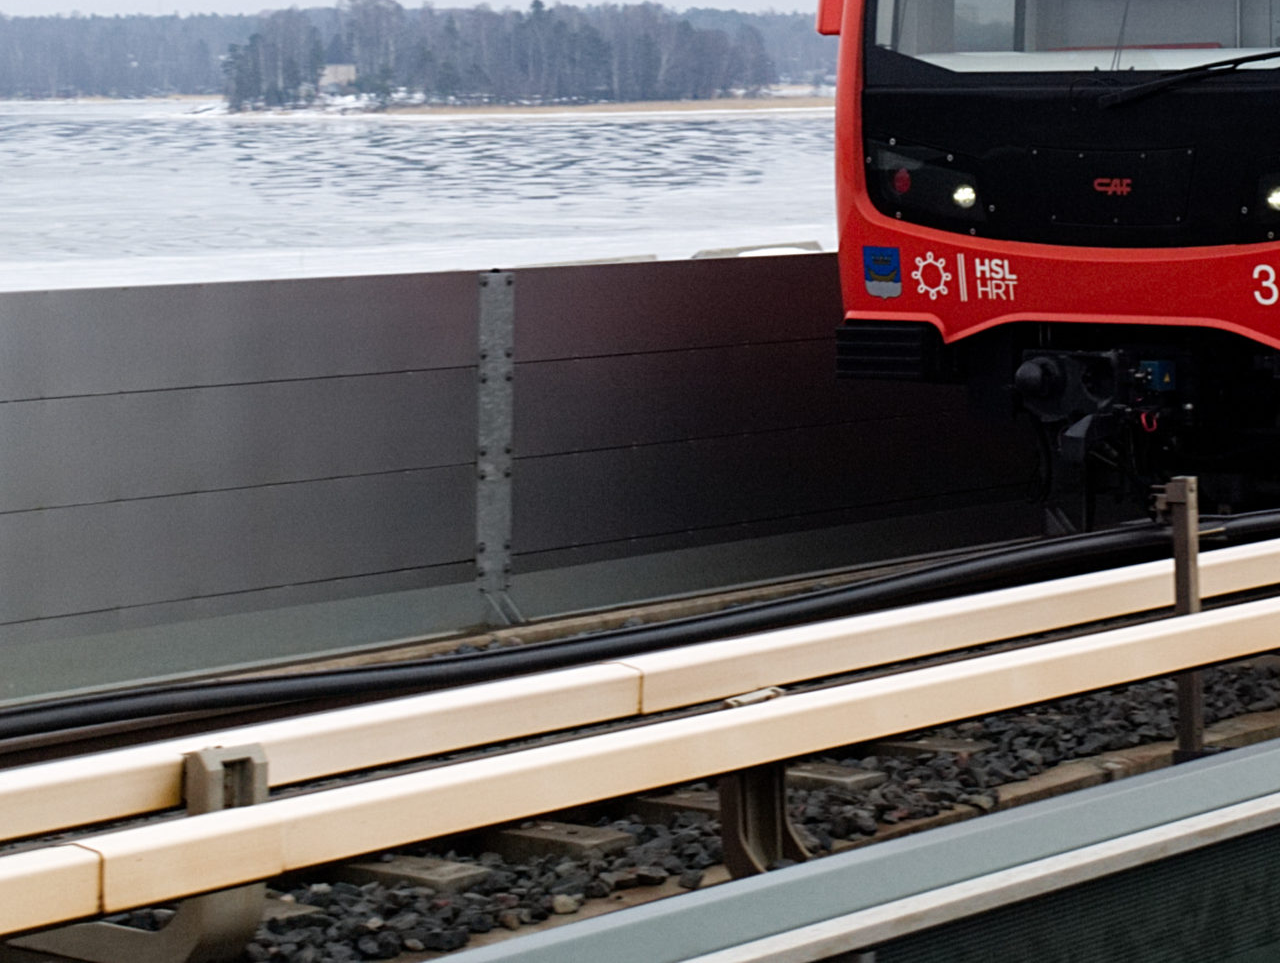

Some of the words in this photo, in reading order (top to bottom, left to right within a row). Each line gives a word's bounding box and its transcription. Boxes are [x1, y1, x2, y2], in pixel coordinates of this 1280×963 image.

[1093, 178, 1132, 196] CAF
[974, 257, 1018, 280] HSL
[977, 279, 1019, 301] HRT
